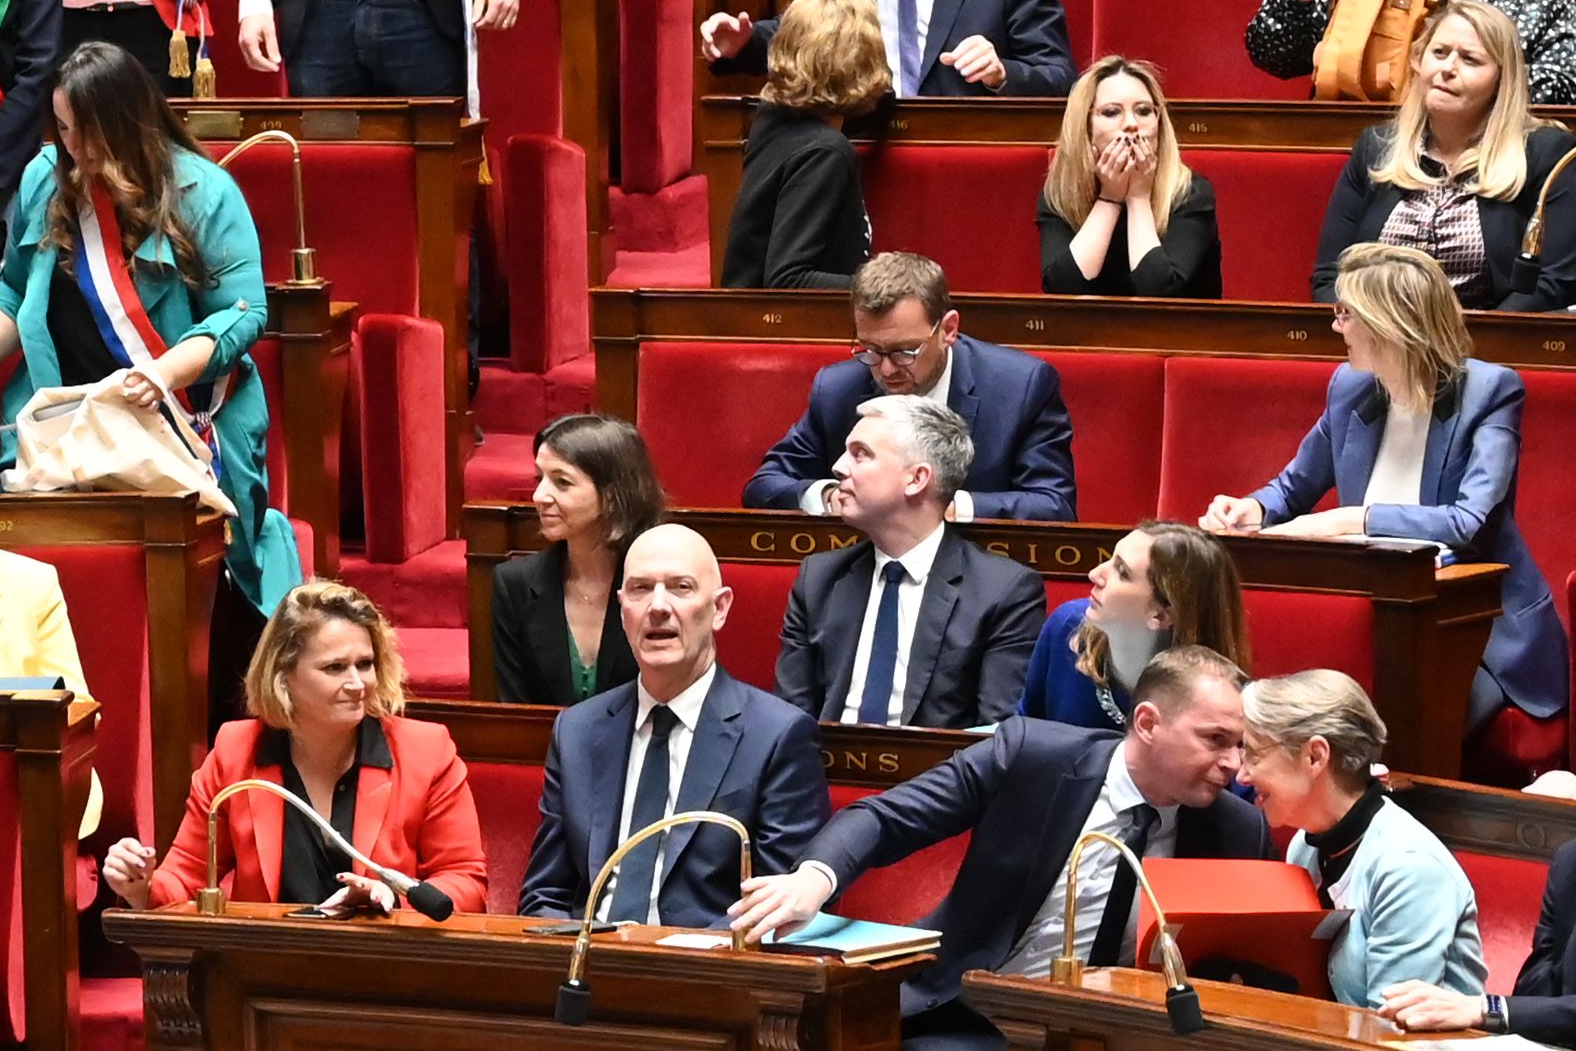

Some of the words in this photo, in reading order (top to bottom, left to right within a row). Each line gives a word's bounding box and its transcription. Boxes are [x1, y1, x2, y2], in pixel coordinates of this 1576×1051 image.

[762, 313, 782, 324] 412
[1025, 320, 1044, 331] 411
[1287, 330, 1308, 341] 410
[1542, 341, 1566, 352] 409
